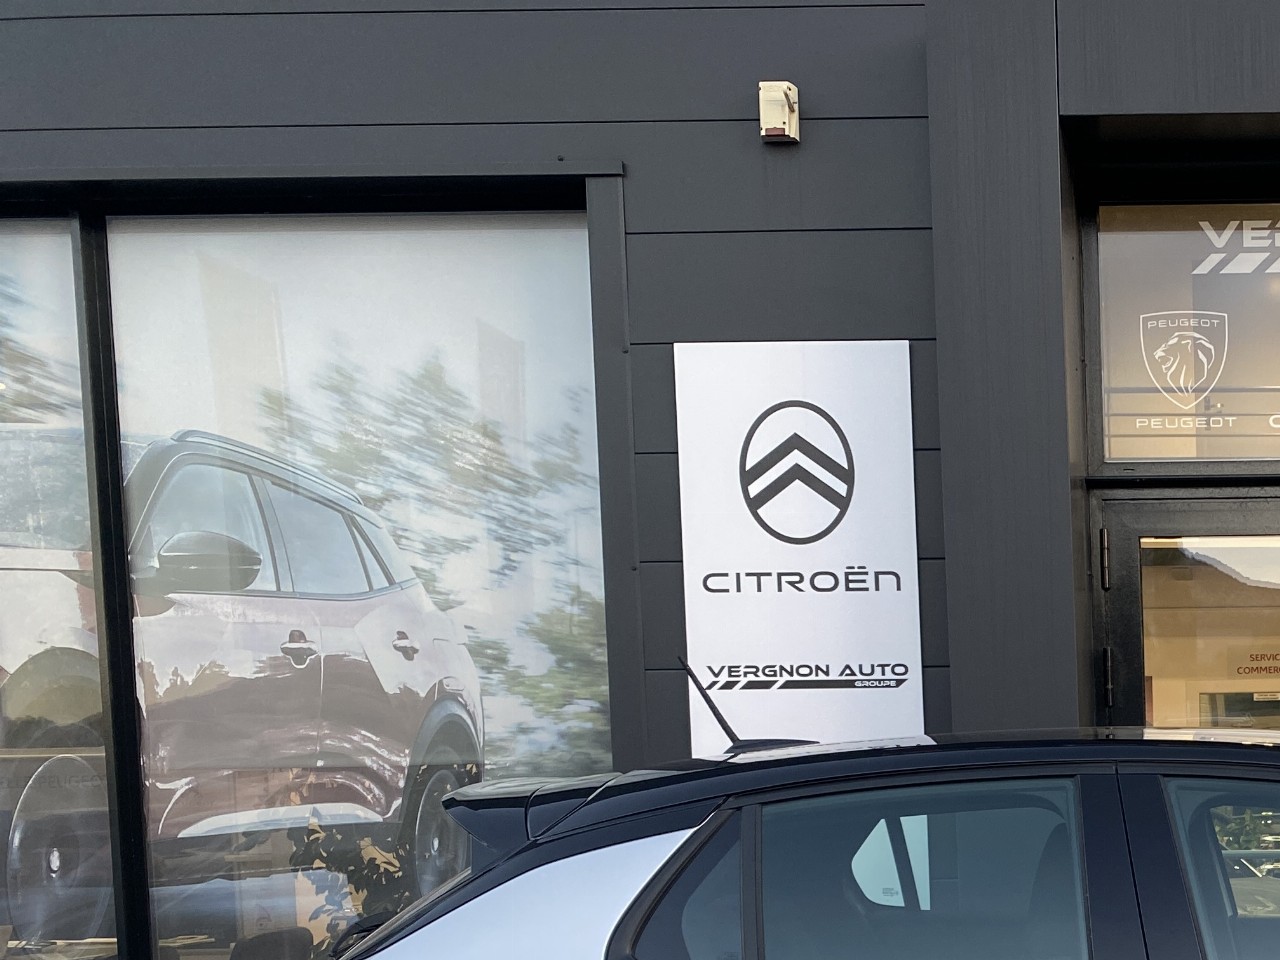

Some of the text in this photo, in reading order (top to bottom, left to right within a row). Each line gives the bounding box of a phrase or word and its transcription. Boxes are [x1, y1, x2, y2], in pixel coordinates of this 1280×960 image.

[1147, 318, 1220, 330] PEUGEOT
[1136, 416, 1237, 429] PEUGEOT
[702, 566, 902, 594] CITROËN
[706, 663, 909, 678] VERGNON AUTO
[854, 680, 897, 688] GROUPE
